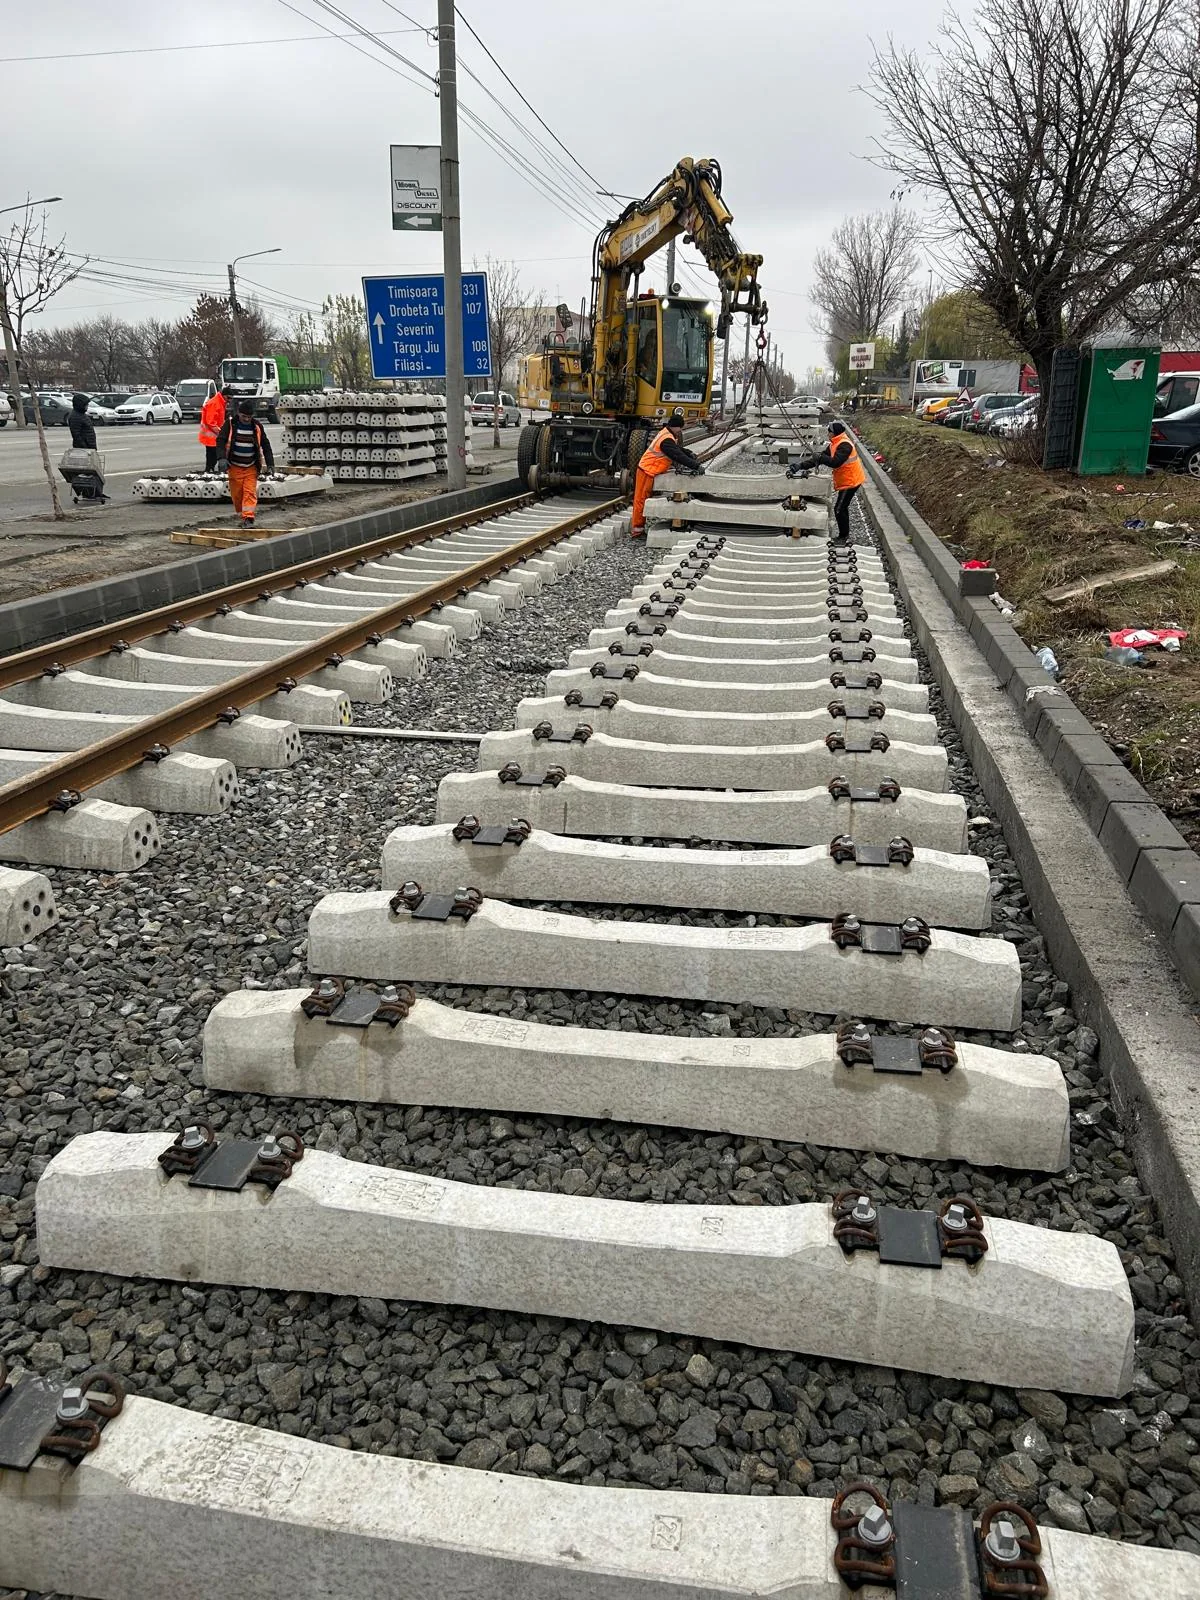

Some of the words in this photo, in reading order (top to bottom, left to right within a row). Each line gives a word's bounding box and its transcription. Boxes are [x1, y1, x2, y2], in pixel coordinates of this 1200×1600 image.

[387, 285, 438, 300] Timișoara
[463, 283, 478, 296] 331
[389, 303, 429, 317] Drobeta
[466, 302, 482, 315] 107
[396, 322, 435, 336] Severin
[393, 341, 421, 357] Târgu
[424, 340, 440, 353] Jiu
[471, 340, 487, 352] 108
[394, 358, 424, 373] Filiași
[476, 358, 489, 370] 32
